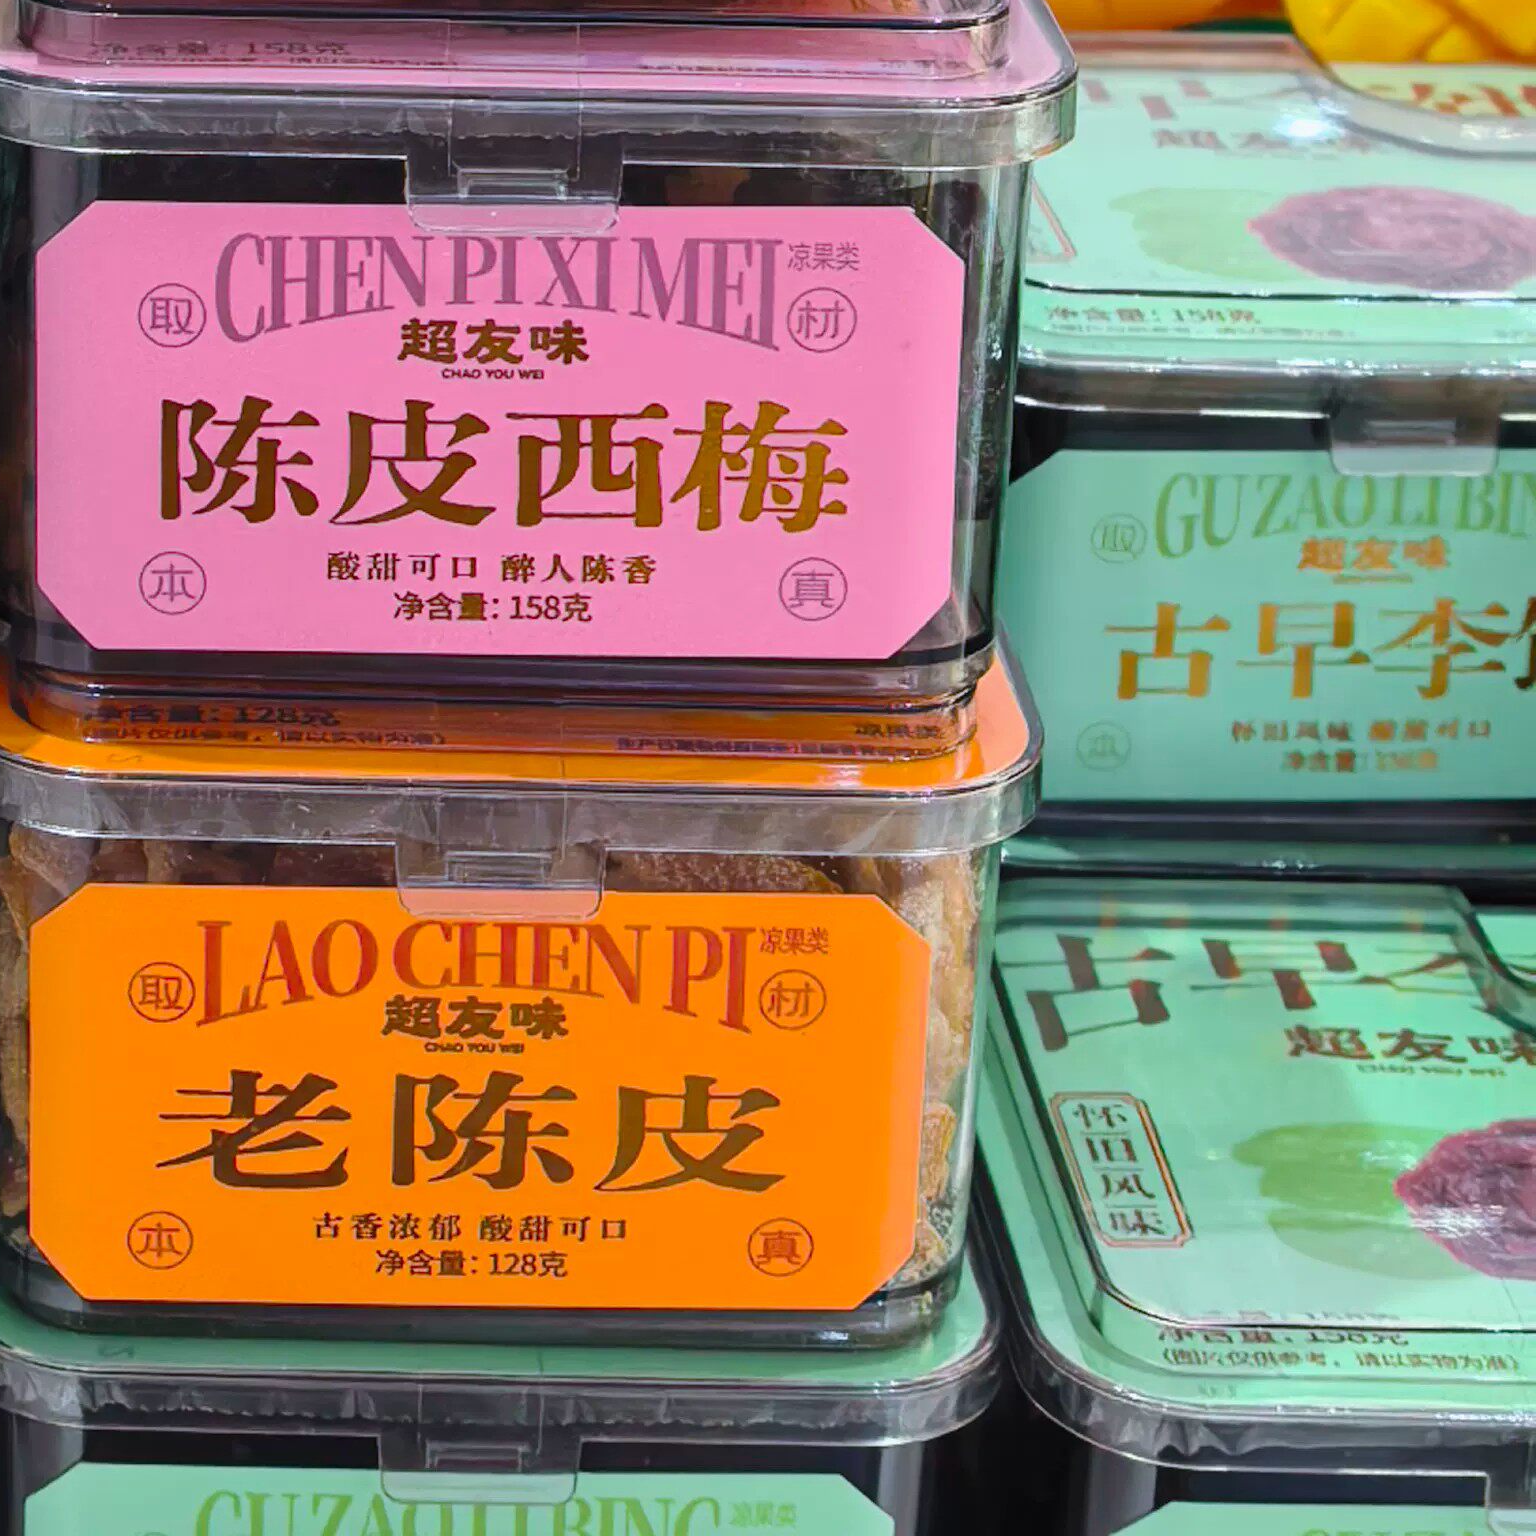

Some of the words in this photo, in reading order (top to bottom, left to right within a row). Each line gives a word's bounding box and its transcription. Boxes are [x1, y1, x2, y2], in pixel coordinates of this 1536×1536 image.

[787, 241, 861, 272] 凉果类
[215, 233, 432, 343] CHEN
[445, 235, 533, 306] PI
[535, 236, 617, 314] XI
[629, 236, 783, 351] MEI
[396, 317, 590, 365] 超友味
[441, 369, 482, 380] CHAO
[485, 369, 515, 380] YOU
[518, 369, 545, 380] WEI
[160, 395, 849, 533] 陈皮西梅
[1153, 472, 1250, 560] GU
[1252, 473, 1376, 539] ZAO
[327, 551, 478, 582] 酸甜可口
[500, 553, 657, 585] 醉人陈香
[393, 590, 593, 623] 净含量：158克
[1104, 596, 1536, 701] 古早李
[759, 926, 830, 956] 凉果类
[195, 919, 379, 1028] LAO
[392, 920, 652, 1005] CHEN
[662, 924, 757, 1034] PI
[380, 994, 570, 1040] 超友味
[467, 1042, 496, 1054] YOU
[499, 1042, 525, 1054] WEI
[154, 1068, 787, 1193] 老陈皮
[312, 1212, 462, 1242] 古香浓郁
[478, 1213, 627, 1243] 酸甜可口
[374, 1248, 569, 1278] 净含量：128克
